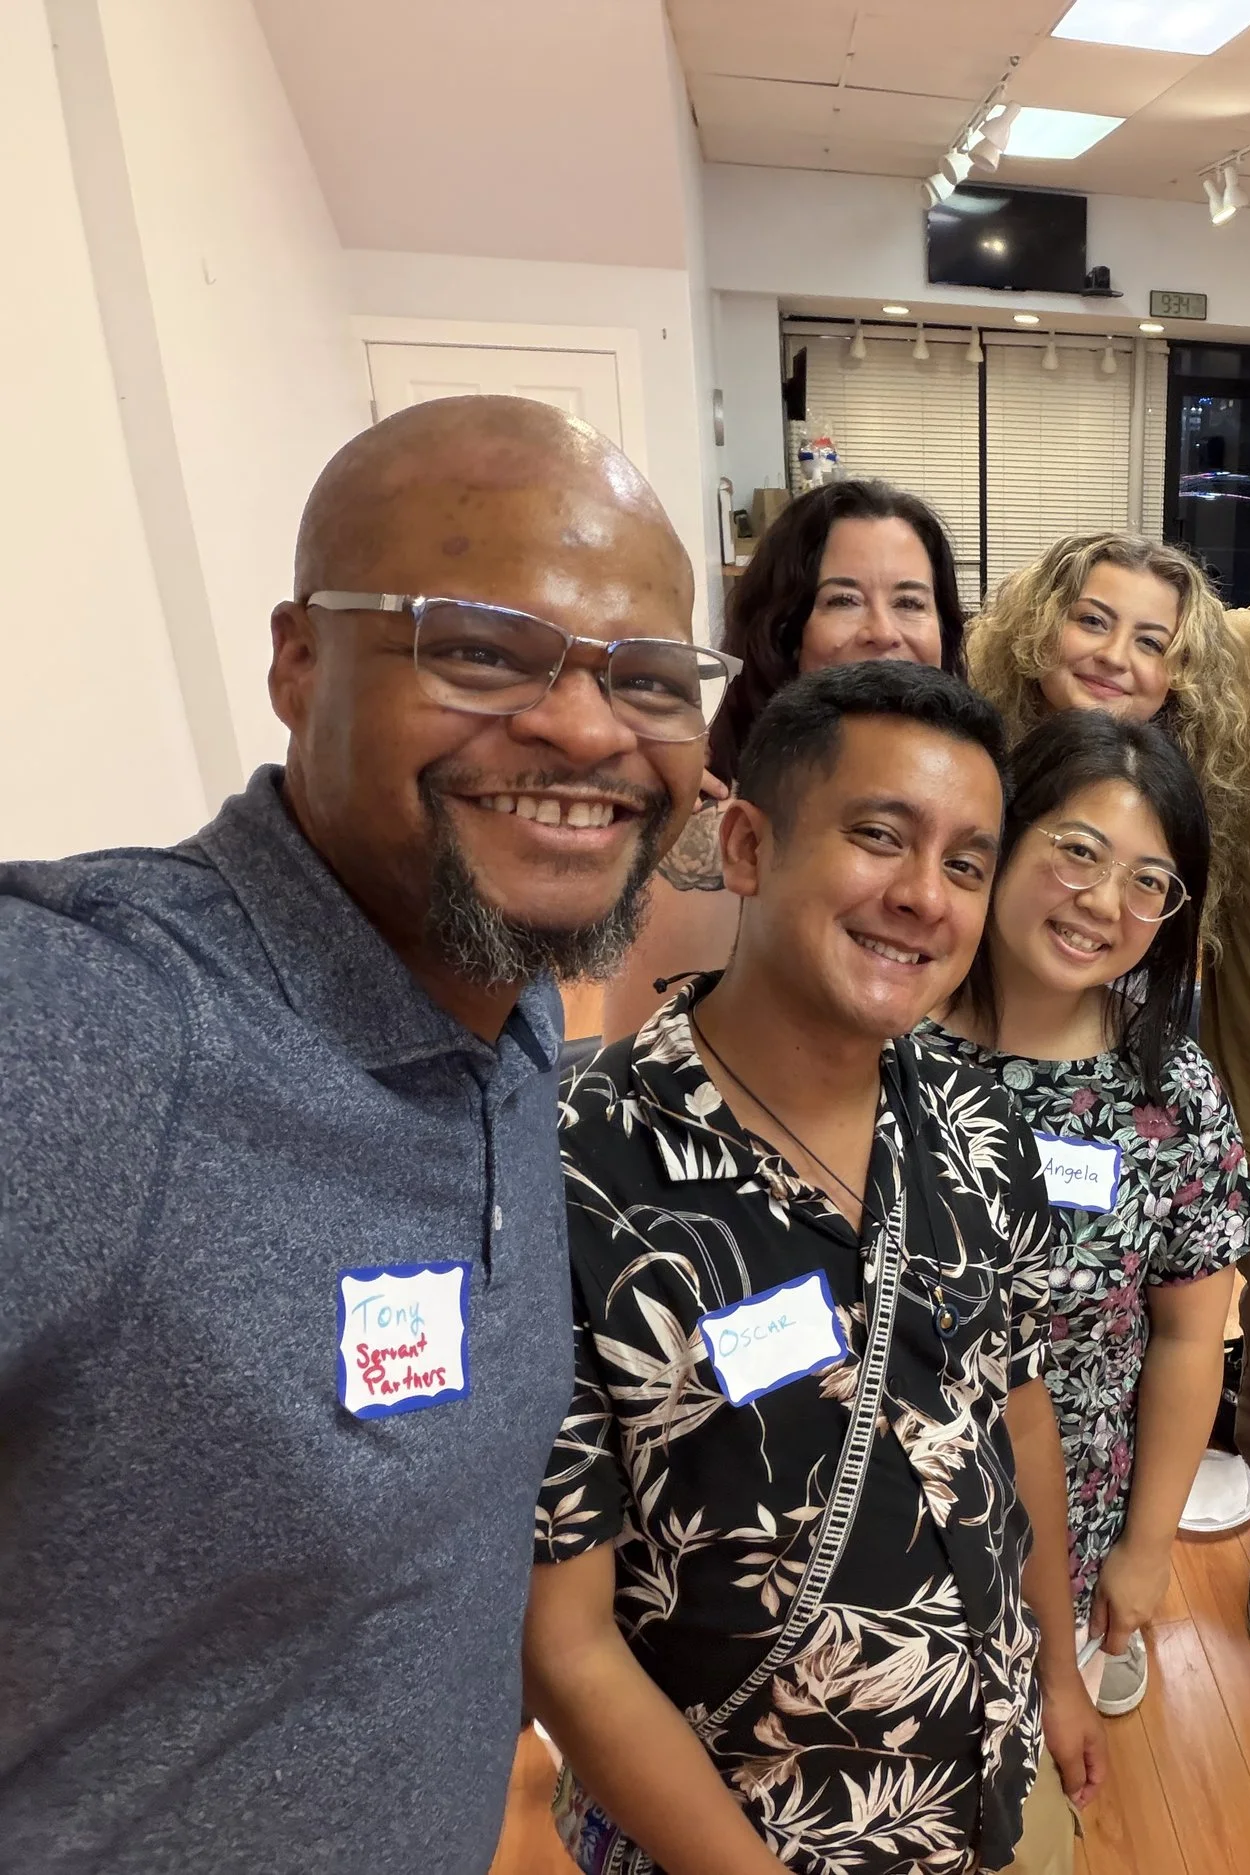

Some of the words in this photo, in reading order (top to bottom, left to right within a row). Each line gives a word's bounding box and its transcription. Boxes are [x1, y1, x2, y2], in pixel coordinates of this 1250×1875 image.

[1043, 1157, 1098, 1184] Angela
[352, 1294, 425, 1336] Tony
[356, 1332, 427, 1369] Servant
[718, 1314, 797, 1357] OSCAR
[362, 1364, 446, 1395] Partners
